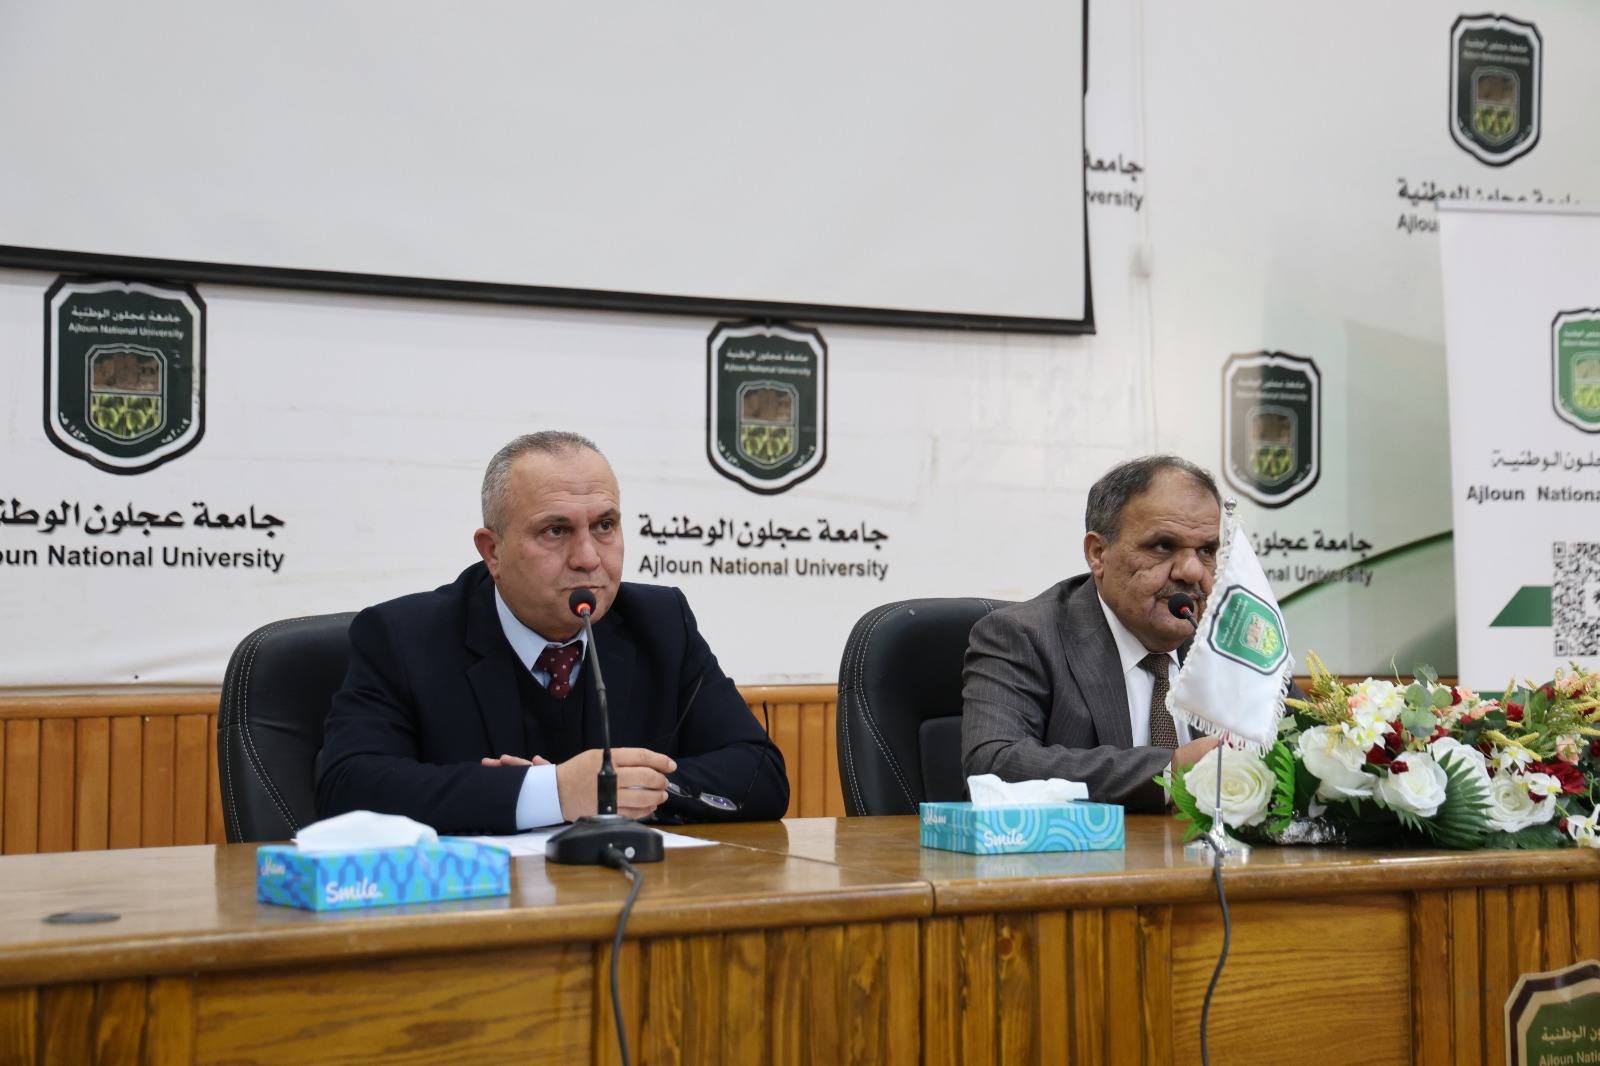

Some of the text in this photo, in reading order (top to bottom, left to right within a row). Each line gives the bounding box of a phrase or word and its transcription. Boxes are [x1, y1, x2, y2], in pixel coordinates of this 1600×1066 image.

[1398, 214, 1438, 234] Ajlou
[100, 324, 138, 336] National
[139, 326, 184, 341] University
[1492, 449, 1562, 472] الوطنية
[1467, 485, 1525, 505] Ajloun
[84, 502, 185, 537] عجلون
[192, 501, 286, 539] جامعة
[638, 513, 889, 550] جامعة عجلون الوطنية
[1314, 530, 1373, 558] جامعة
[48, 545, 153, 567] National
[162, 547, 285, 573] University
[639, 554, 889, 581] Ajloun National University
